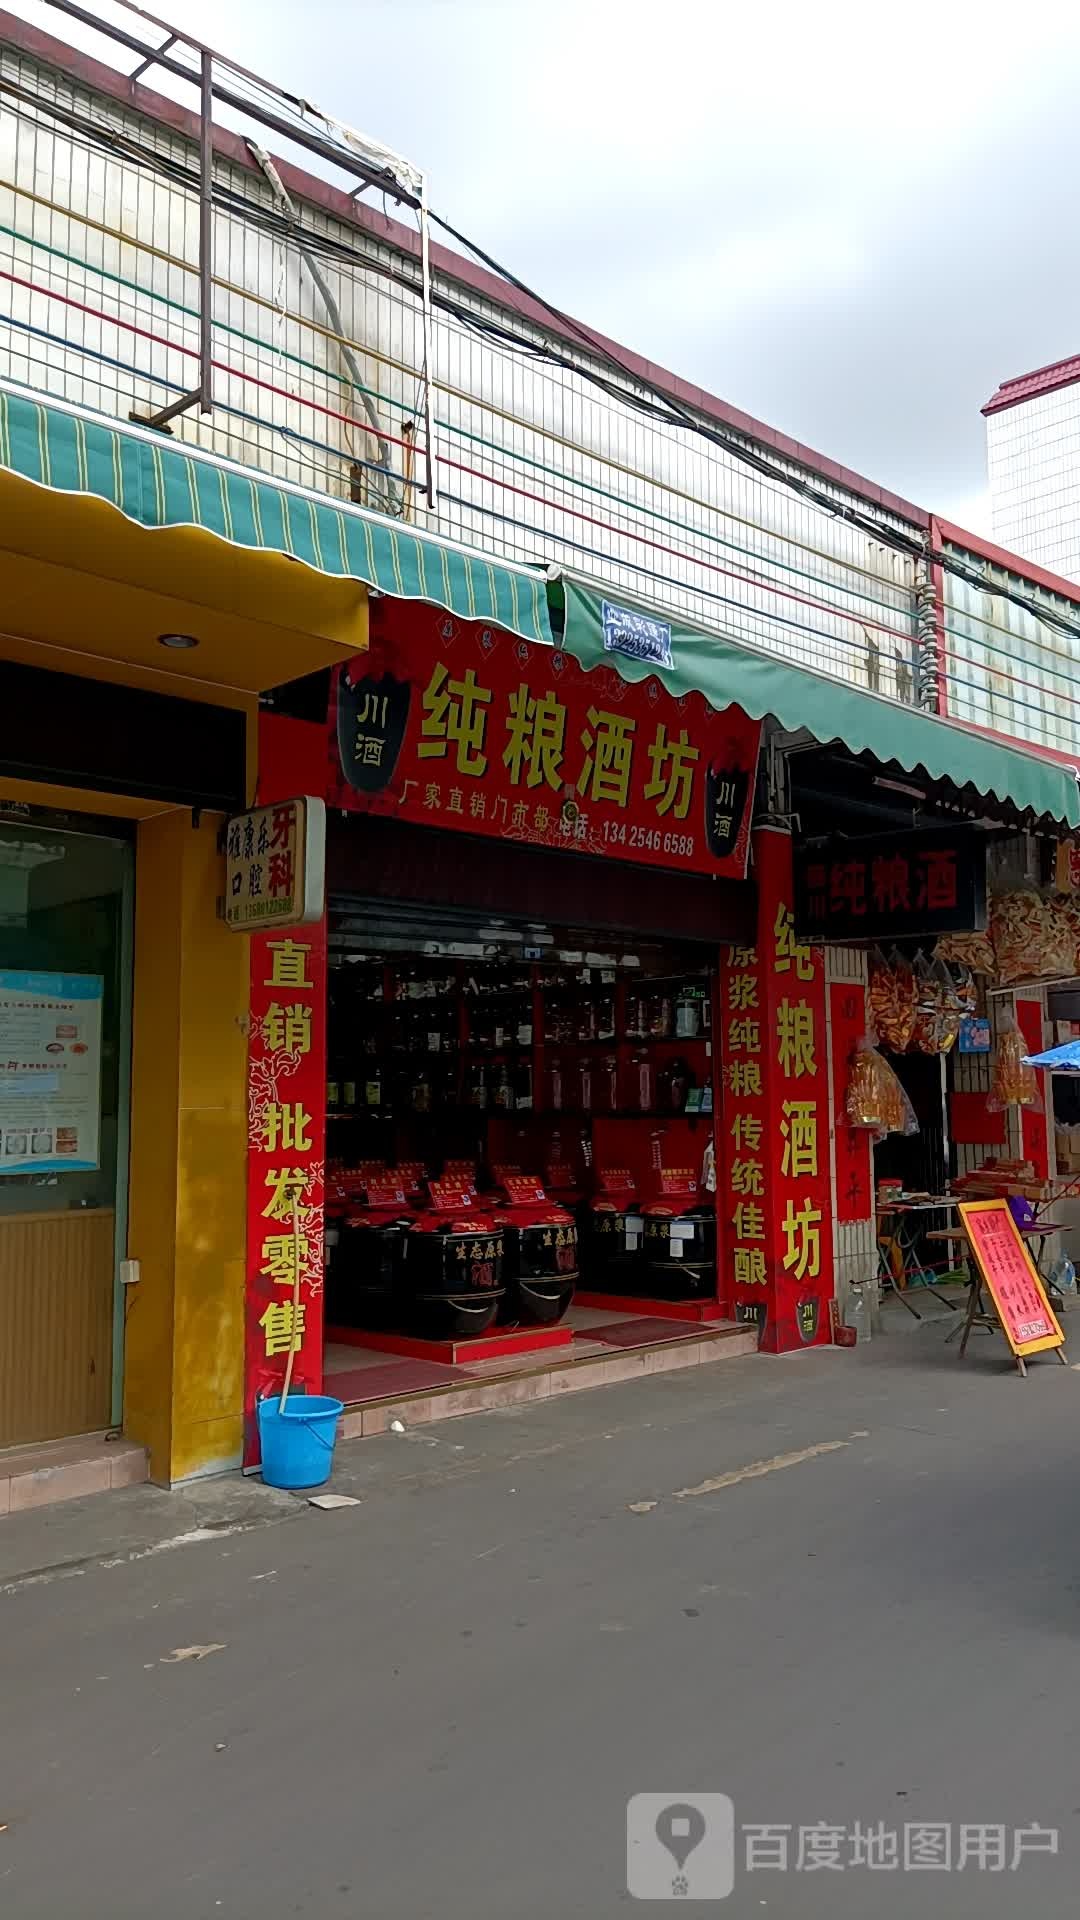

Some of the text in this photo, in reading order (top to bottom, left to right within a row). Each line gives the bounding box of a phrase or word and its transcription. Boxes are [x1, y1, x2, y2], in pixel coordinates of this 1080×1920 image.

[356, 693, 388, 768] 川酒
[417, 661, 700, 819] 纯粮酒坊
[398, 778, 549, 833] 厂家直销门市部
[603, 820, 626, 844] 134
[629, 824, 661, 850] 2546
[664, 830, 694, 857] 6588
[715, 781, 735, 839] 川酒
[231, 863, 263, 897] 口腔
[267, 804, 297, 898] 牙科
[829, 848, 959, 917] 纯粮酒
[773, 902, 823, 1281] 纯粮酒坊
